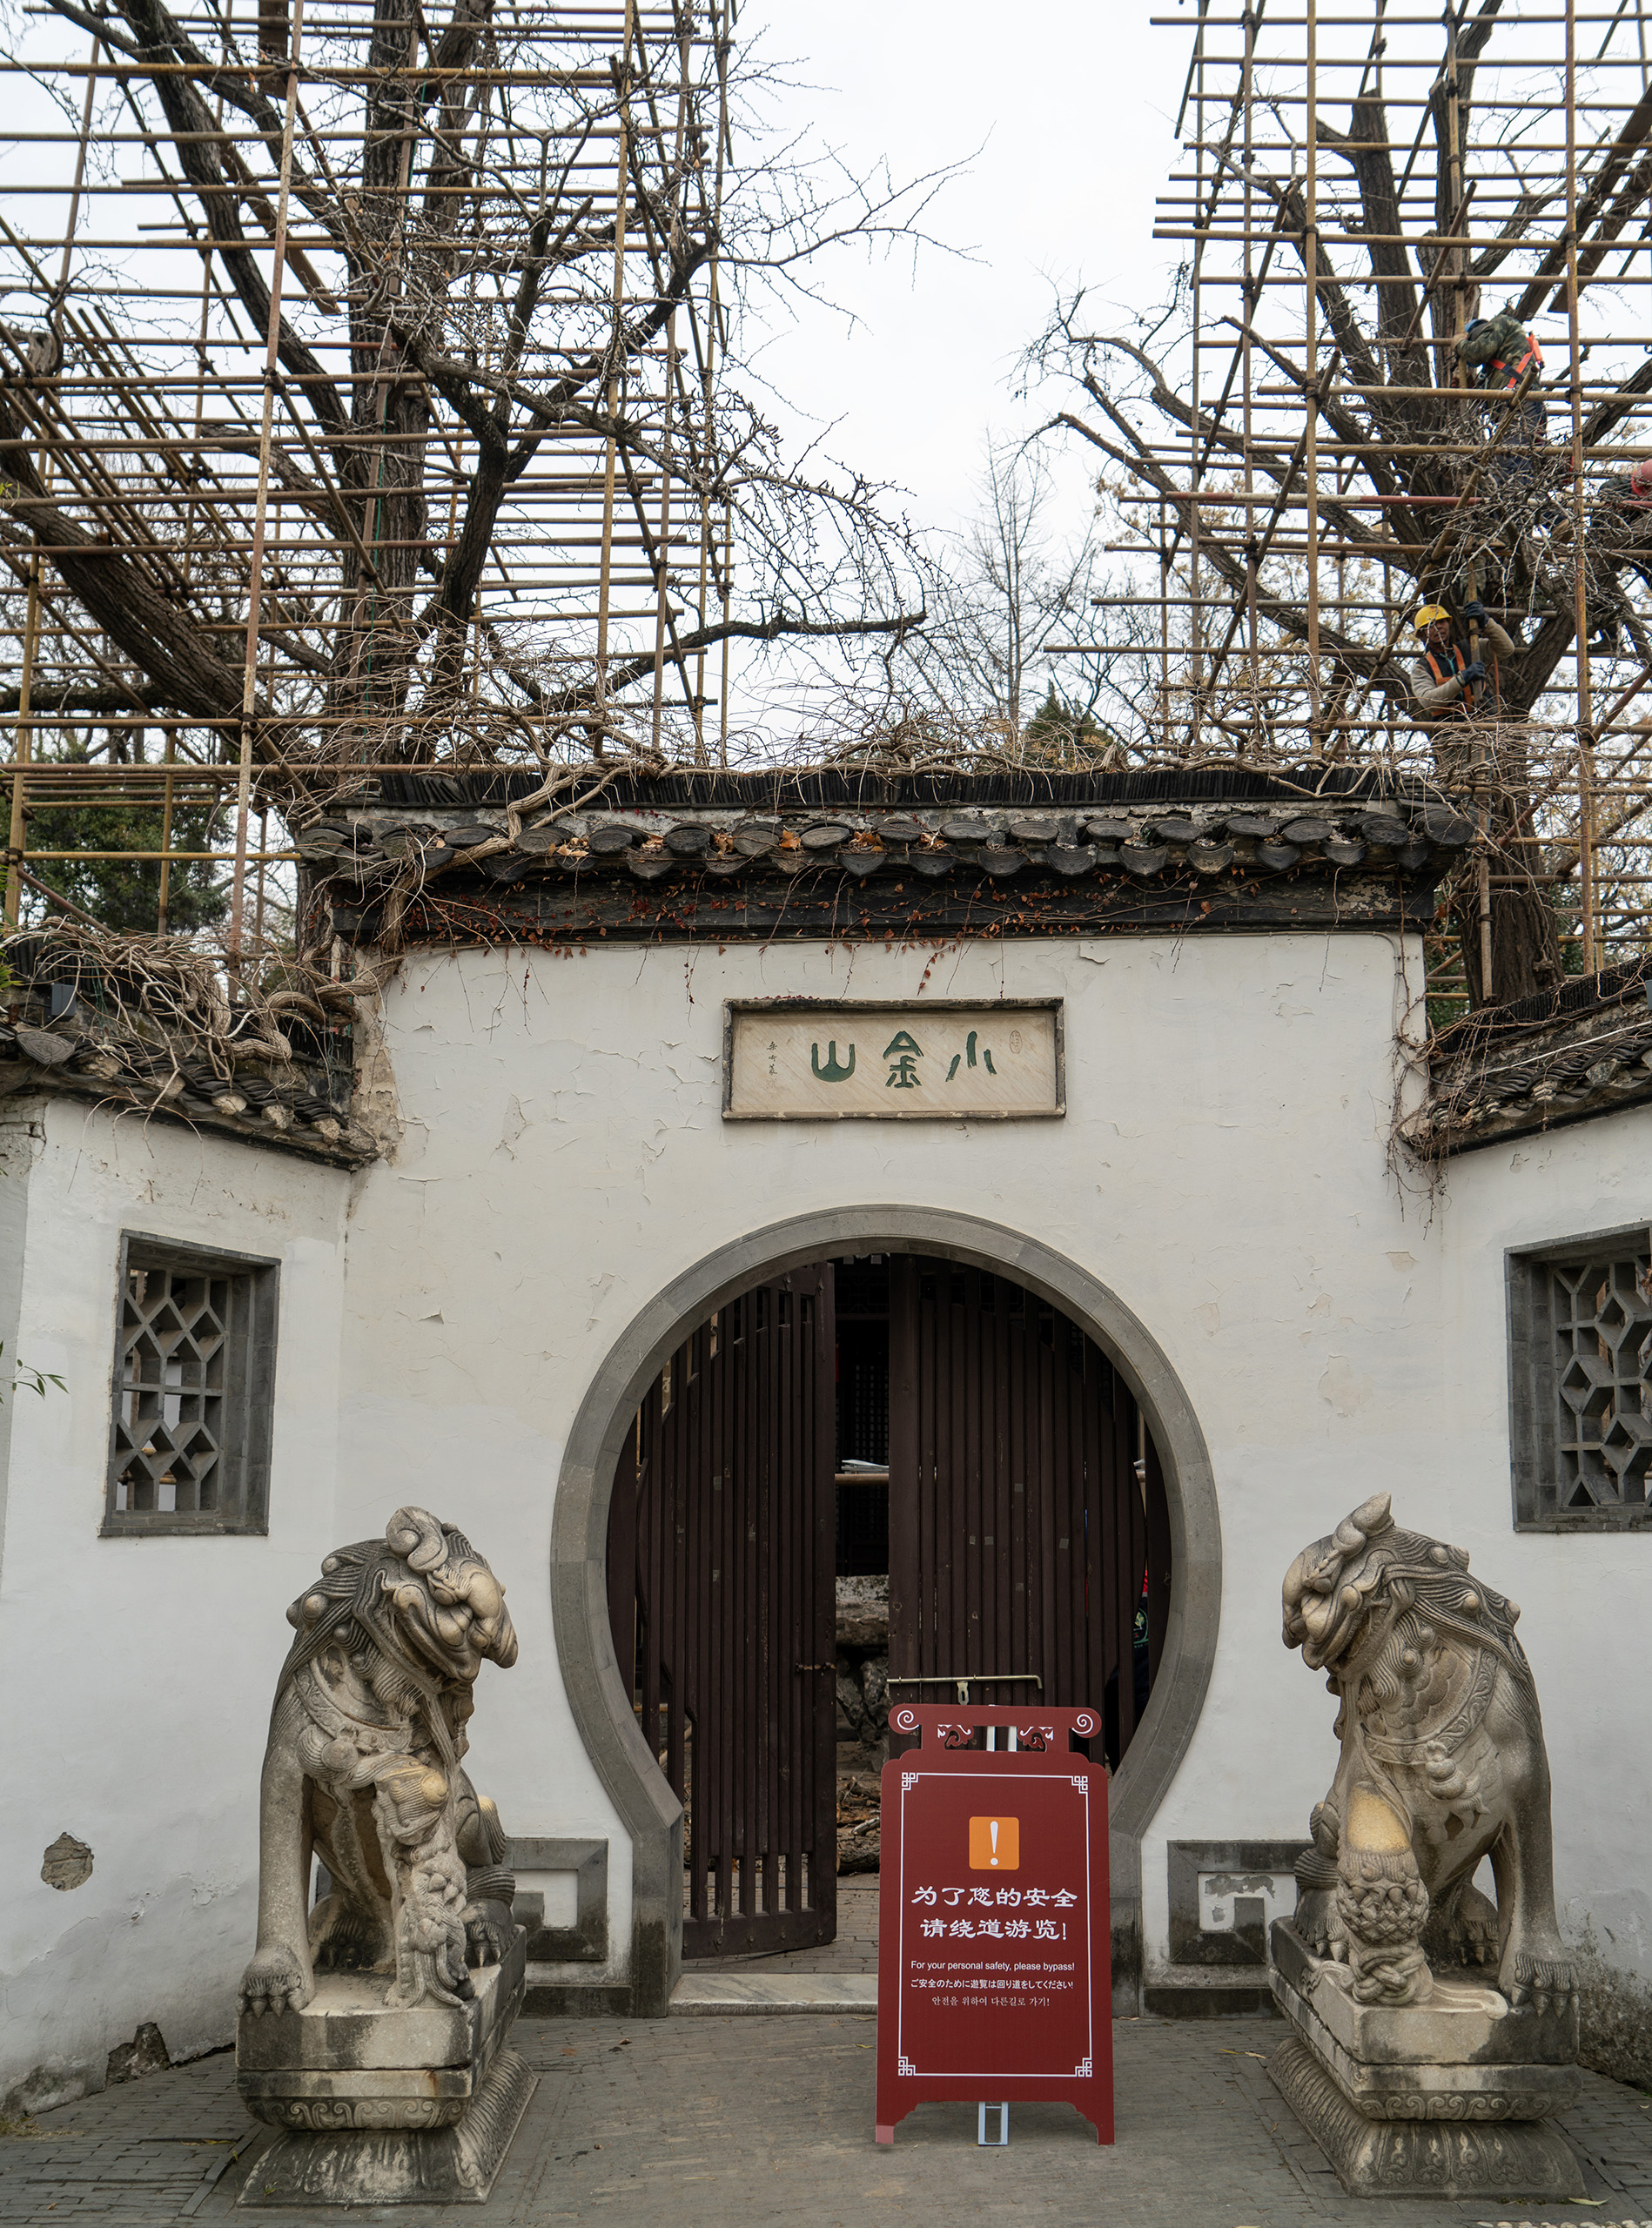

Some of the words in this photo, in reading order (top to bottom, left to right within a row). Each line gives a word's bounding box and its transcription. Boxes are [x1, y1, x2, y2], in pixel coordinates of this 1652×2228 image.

[911, 1886, 1078, 1907] 为了您的安全
[920, 1918, 1067, 1941] 请绕道游览!
[910, 1960, 925, 1970] For
[927, 1962, 946, 1971] your
[947, 1961, 984, 1971] personal
[984, 1961, 1011, 1972] safety,
[1013, 1962, 1041, 1972] please
[1043, 1962, 1075, 1972] bypass!
[931, 1996, 958, 2006] 안전을
[962, 1996, 987, 2006] 위하여
[1029, 1996, 1050, 2007] 가기!
